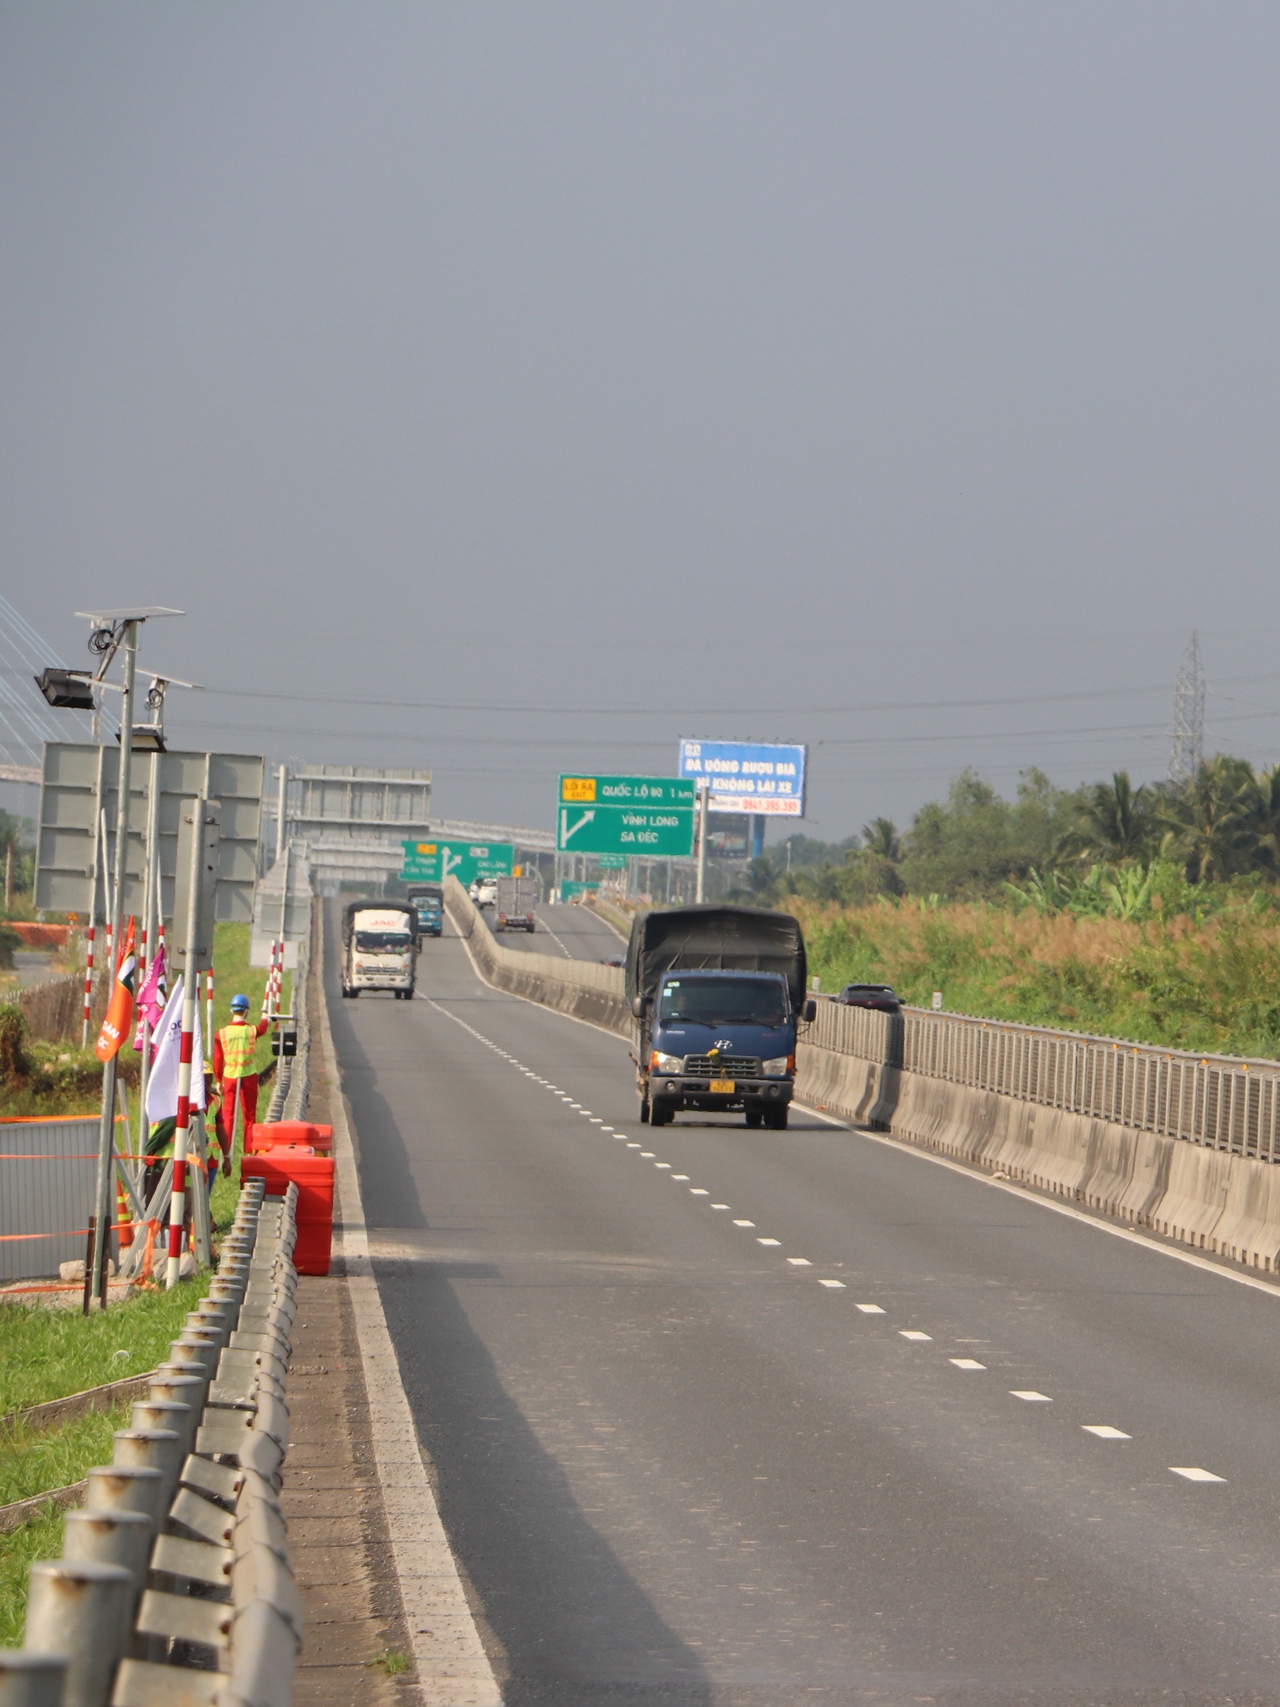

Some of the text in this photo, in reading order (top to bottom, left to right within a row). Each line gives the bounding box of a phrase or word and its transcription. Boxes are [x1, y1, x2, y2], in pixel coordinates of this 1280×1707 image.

[704, 757, 739, 773] UỐNG
[603, 782, 631, 797] QUỐC
[634, 784, 649, 799] LỘ
[671, 788, 676, 798] 1
[678, 789, 693, 799] km
[712, 776, 755, 792] KHÔNG
[757, 778, 776, 793] LÁI
[777, 781, 792, 793] XE
[621, 811, 679, 827] VĨNH LONG
[620, 829, 659, 843] SA ĐÉC
